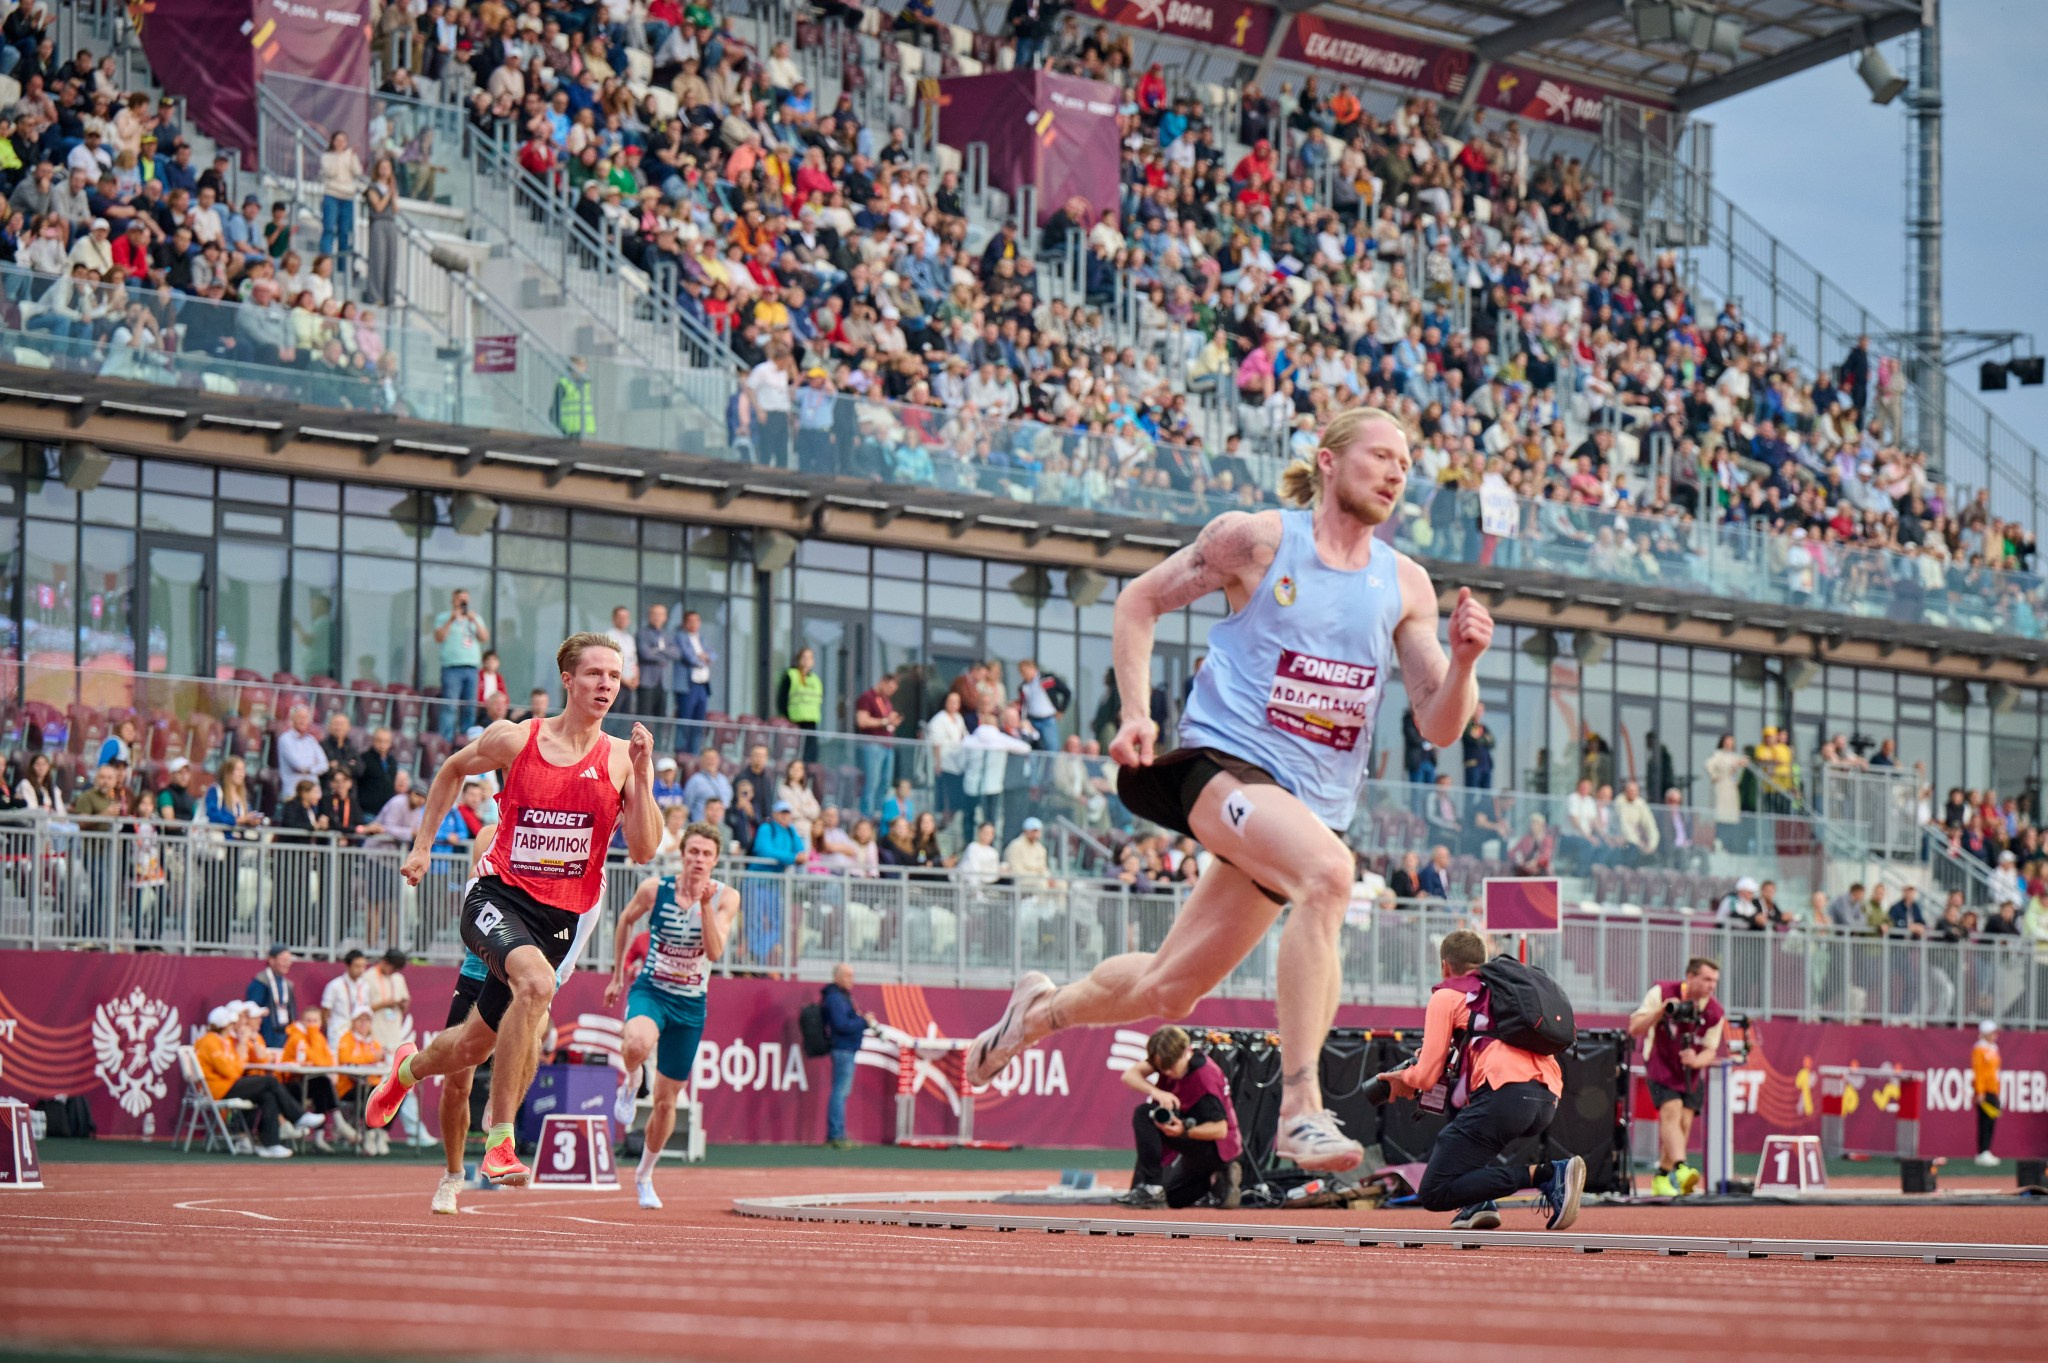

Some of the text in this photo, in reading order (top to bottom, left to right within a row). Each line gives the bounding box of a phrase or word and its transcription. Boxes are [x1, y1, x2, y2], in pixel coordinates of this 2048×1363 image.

[1288, 655, 1375, 688] FONBET
[523, 809, 587, 827] FONBET
[1228, 802, 1244, 827] 4
[514, 832, 589, 853] ГАВРИЛЮК
[513, 863, 542, 872] КОРОЛЕВА
[483, 912, 496, 928] 3
[662, 944, 700, 958] FONBET
[690, 1038, 809, 1092] ВФЛА
[971, 1048, 1070, 1096] ФЛА
[1926, 1067, 2048, 1113] КОРЛЕВ
[21, 1121, 33, 1166] 4
[552, 1131, 577, 1171] 3
[595, 1131, 610, 1172] 3
[1773, 1149, 1790, 1183] 1
[1806, 1150, 1820, 1183] 1
